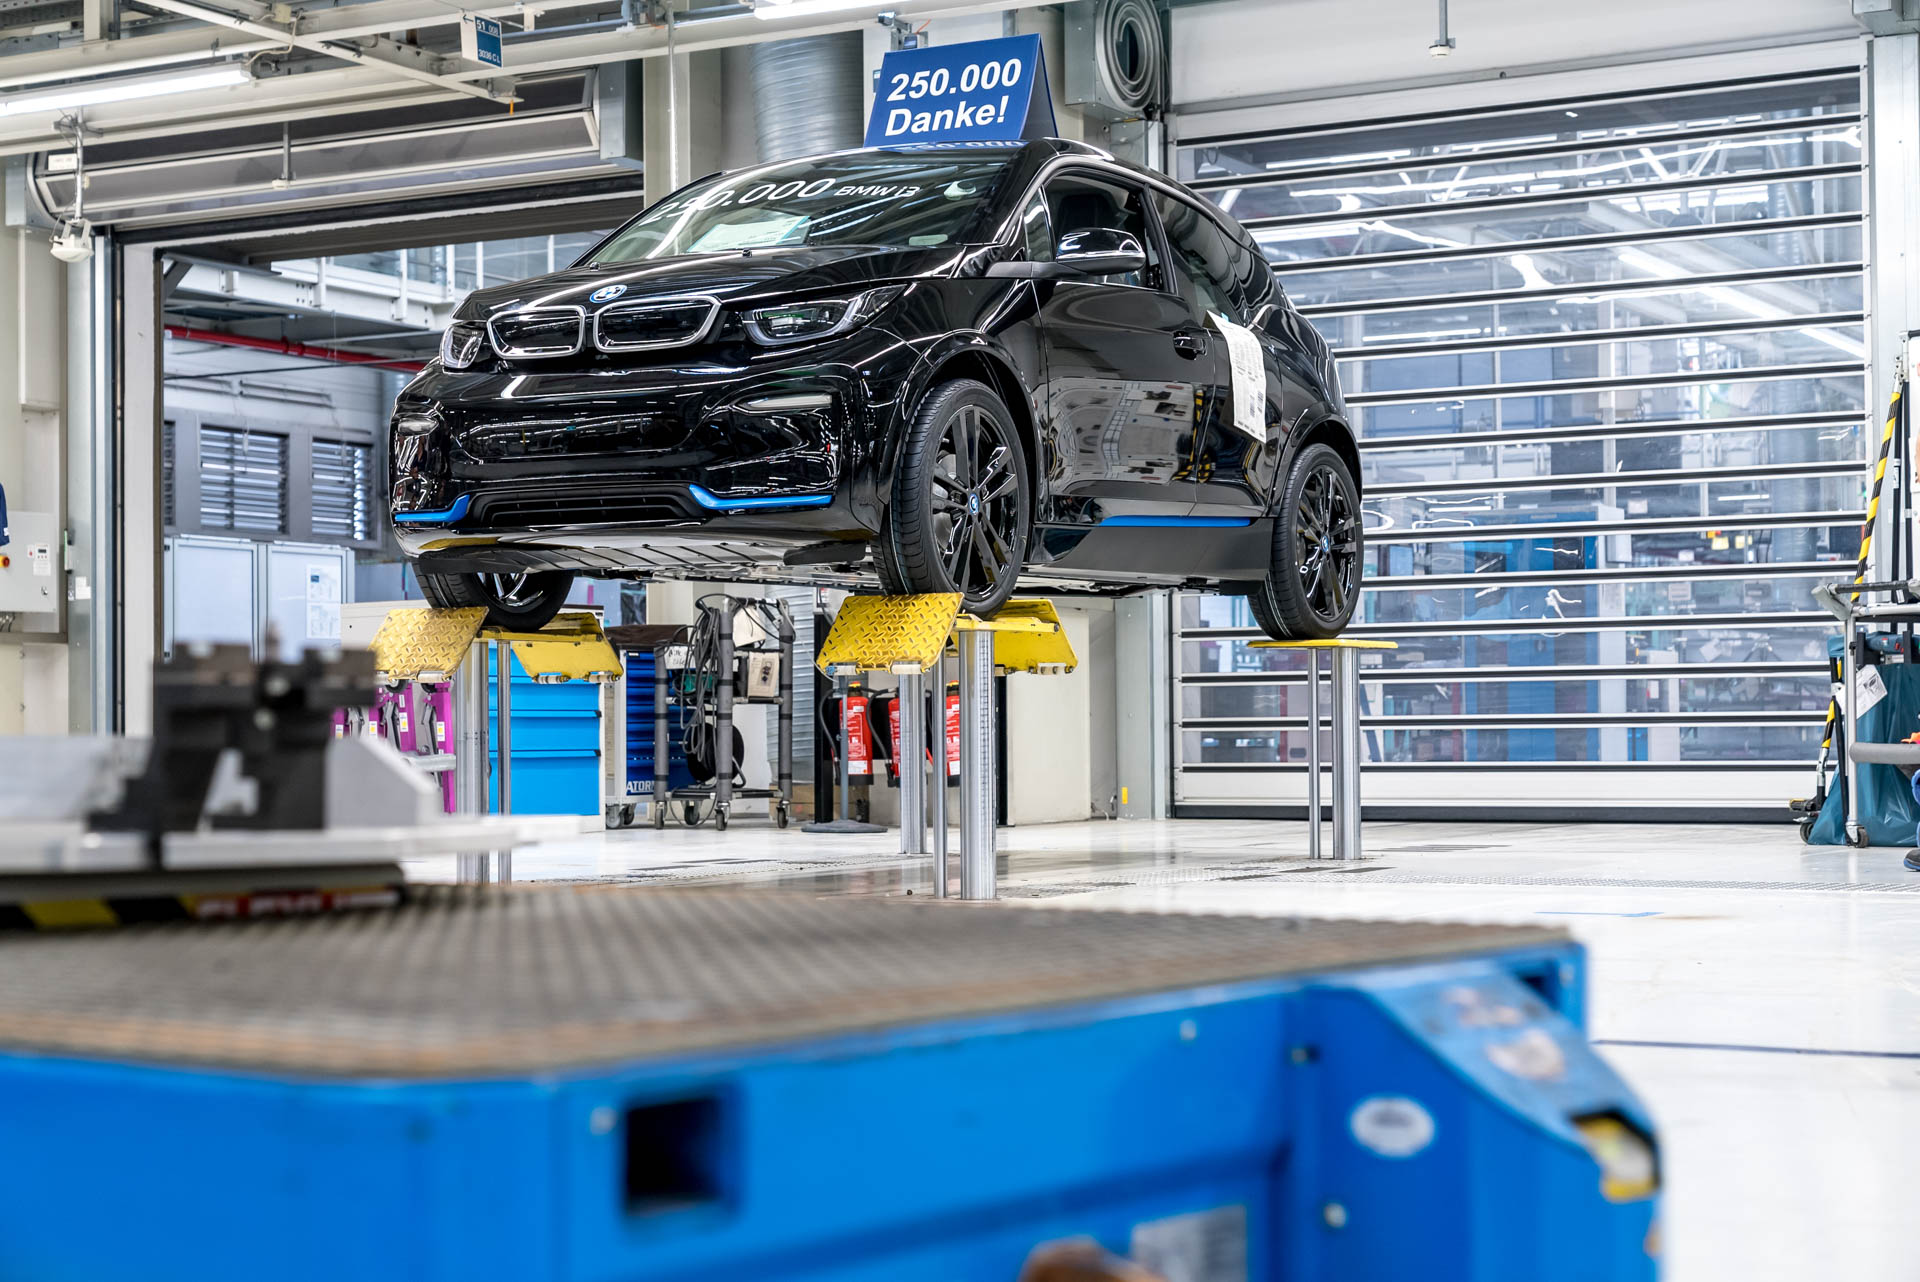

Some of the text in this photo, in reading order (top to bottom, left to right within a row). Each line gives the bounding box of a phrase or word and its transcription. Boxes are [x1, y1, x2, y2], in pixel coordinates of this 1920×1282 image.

[886, 58, 1022, 102] 250.000
[884, 95, 1009, 136] Danke!
[834, 185, 897, 196] BMW
[894, 186, 920, 197] i3
[627, 780, 655, 793] ATOR
